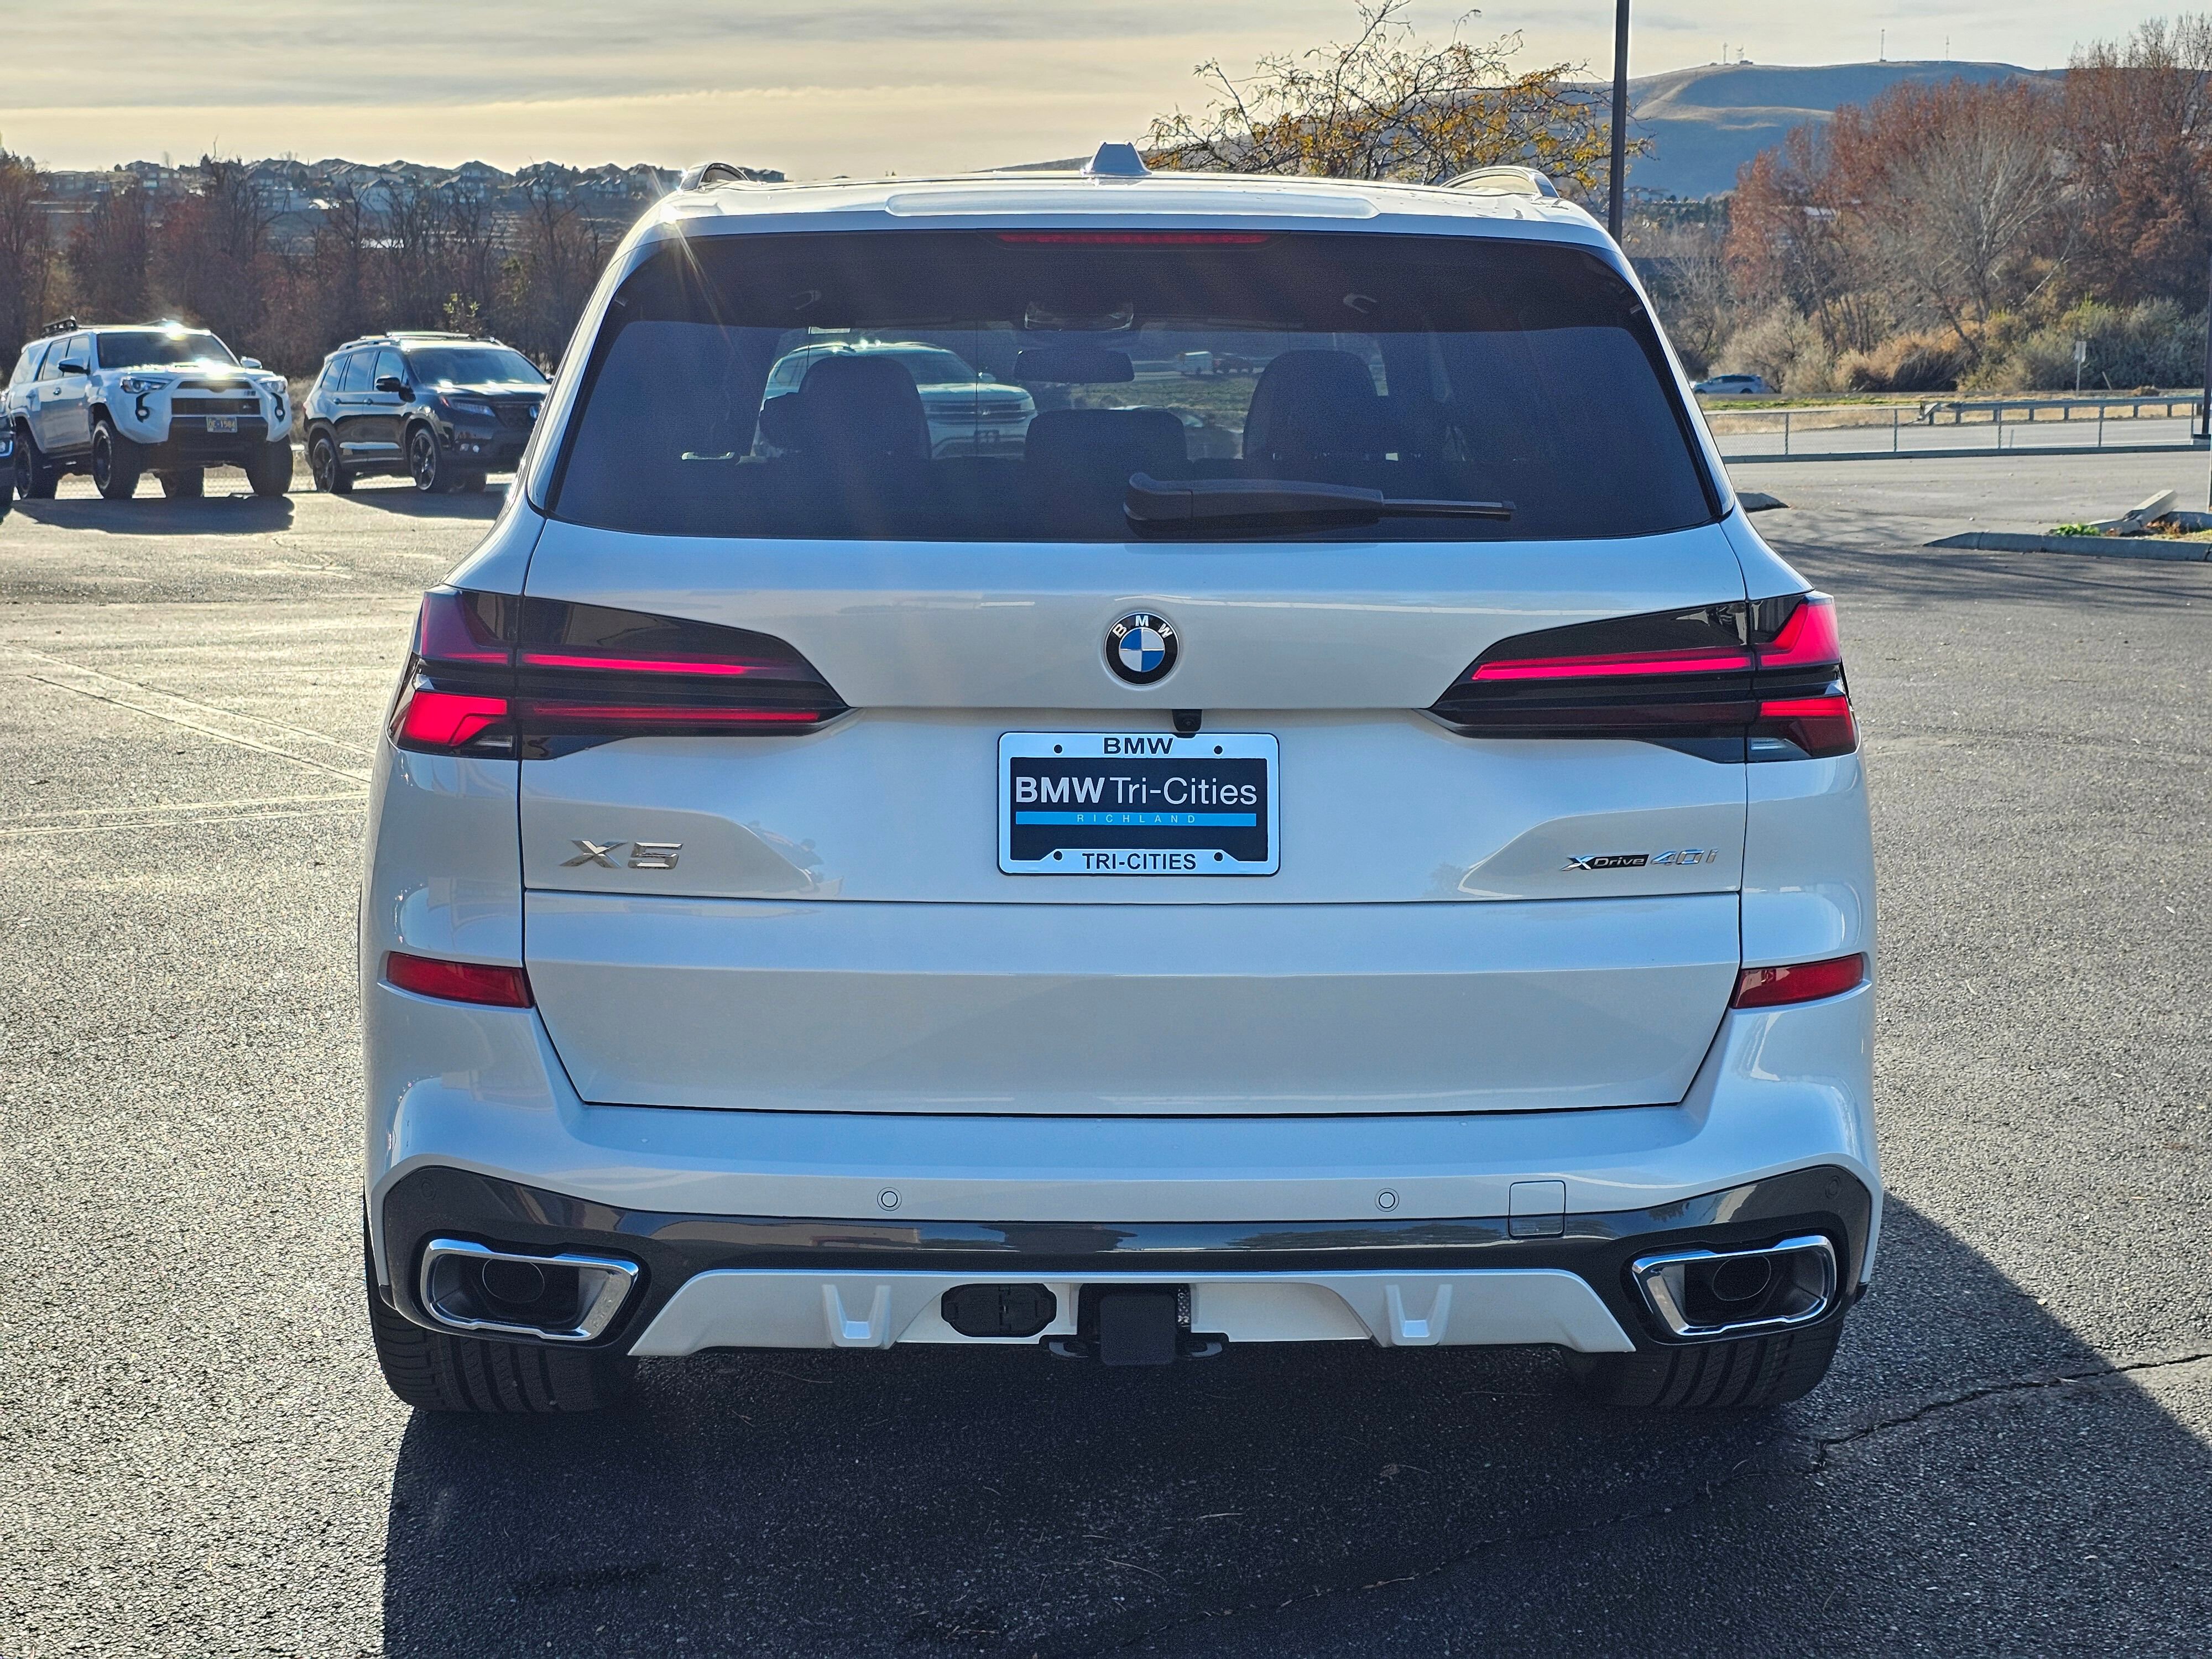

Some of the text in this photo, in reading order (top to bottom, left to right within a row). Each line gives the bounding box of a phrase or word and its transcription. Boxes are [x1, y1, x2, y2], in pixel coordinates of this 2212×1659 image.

[1113, 615, 1173, 638] BMW
[1104, 737, 1173, 754] BMW
[1016, 777, 1257, 805] BMW Tri-Cities
[1077, 814, 1196, 823] RICHLAND
[559, 840, 684, 869] X5
[1082, 853, 1196, 870] TRI-CITIES
